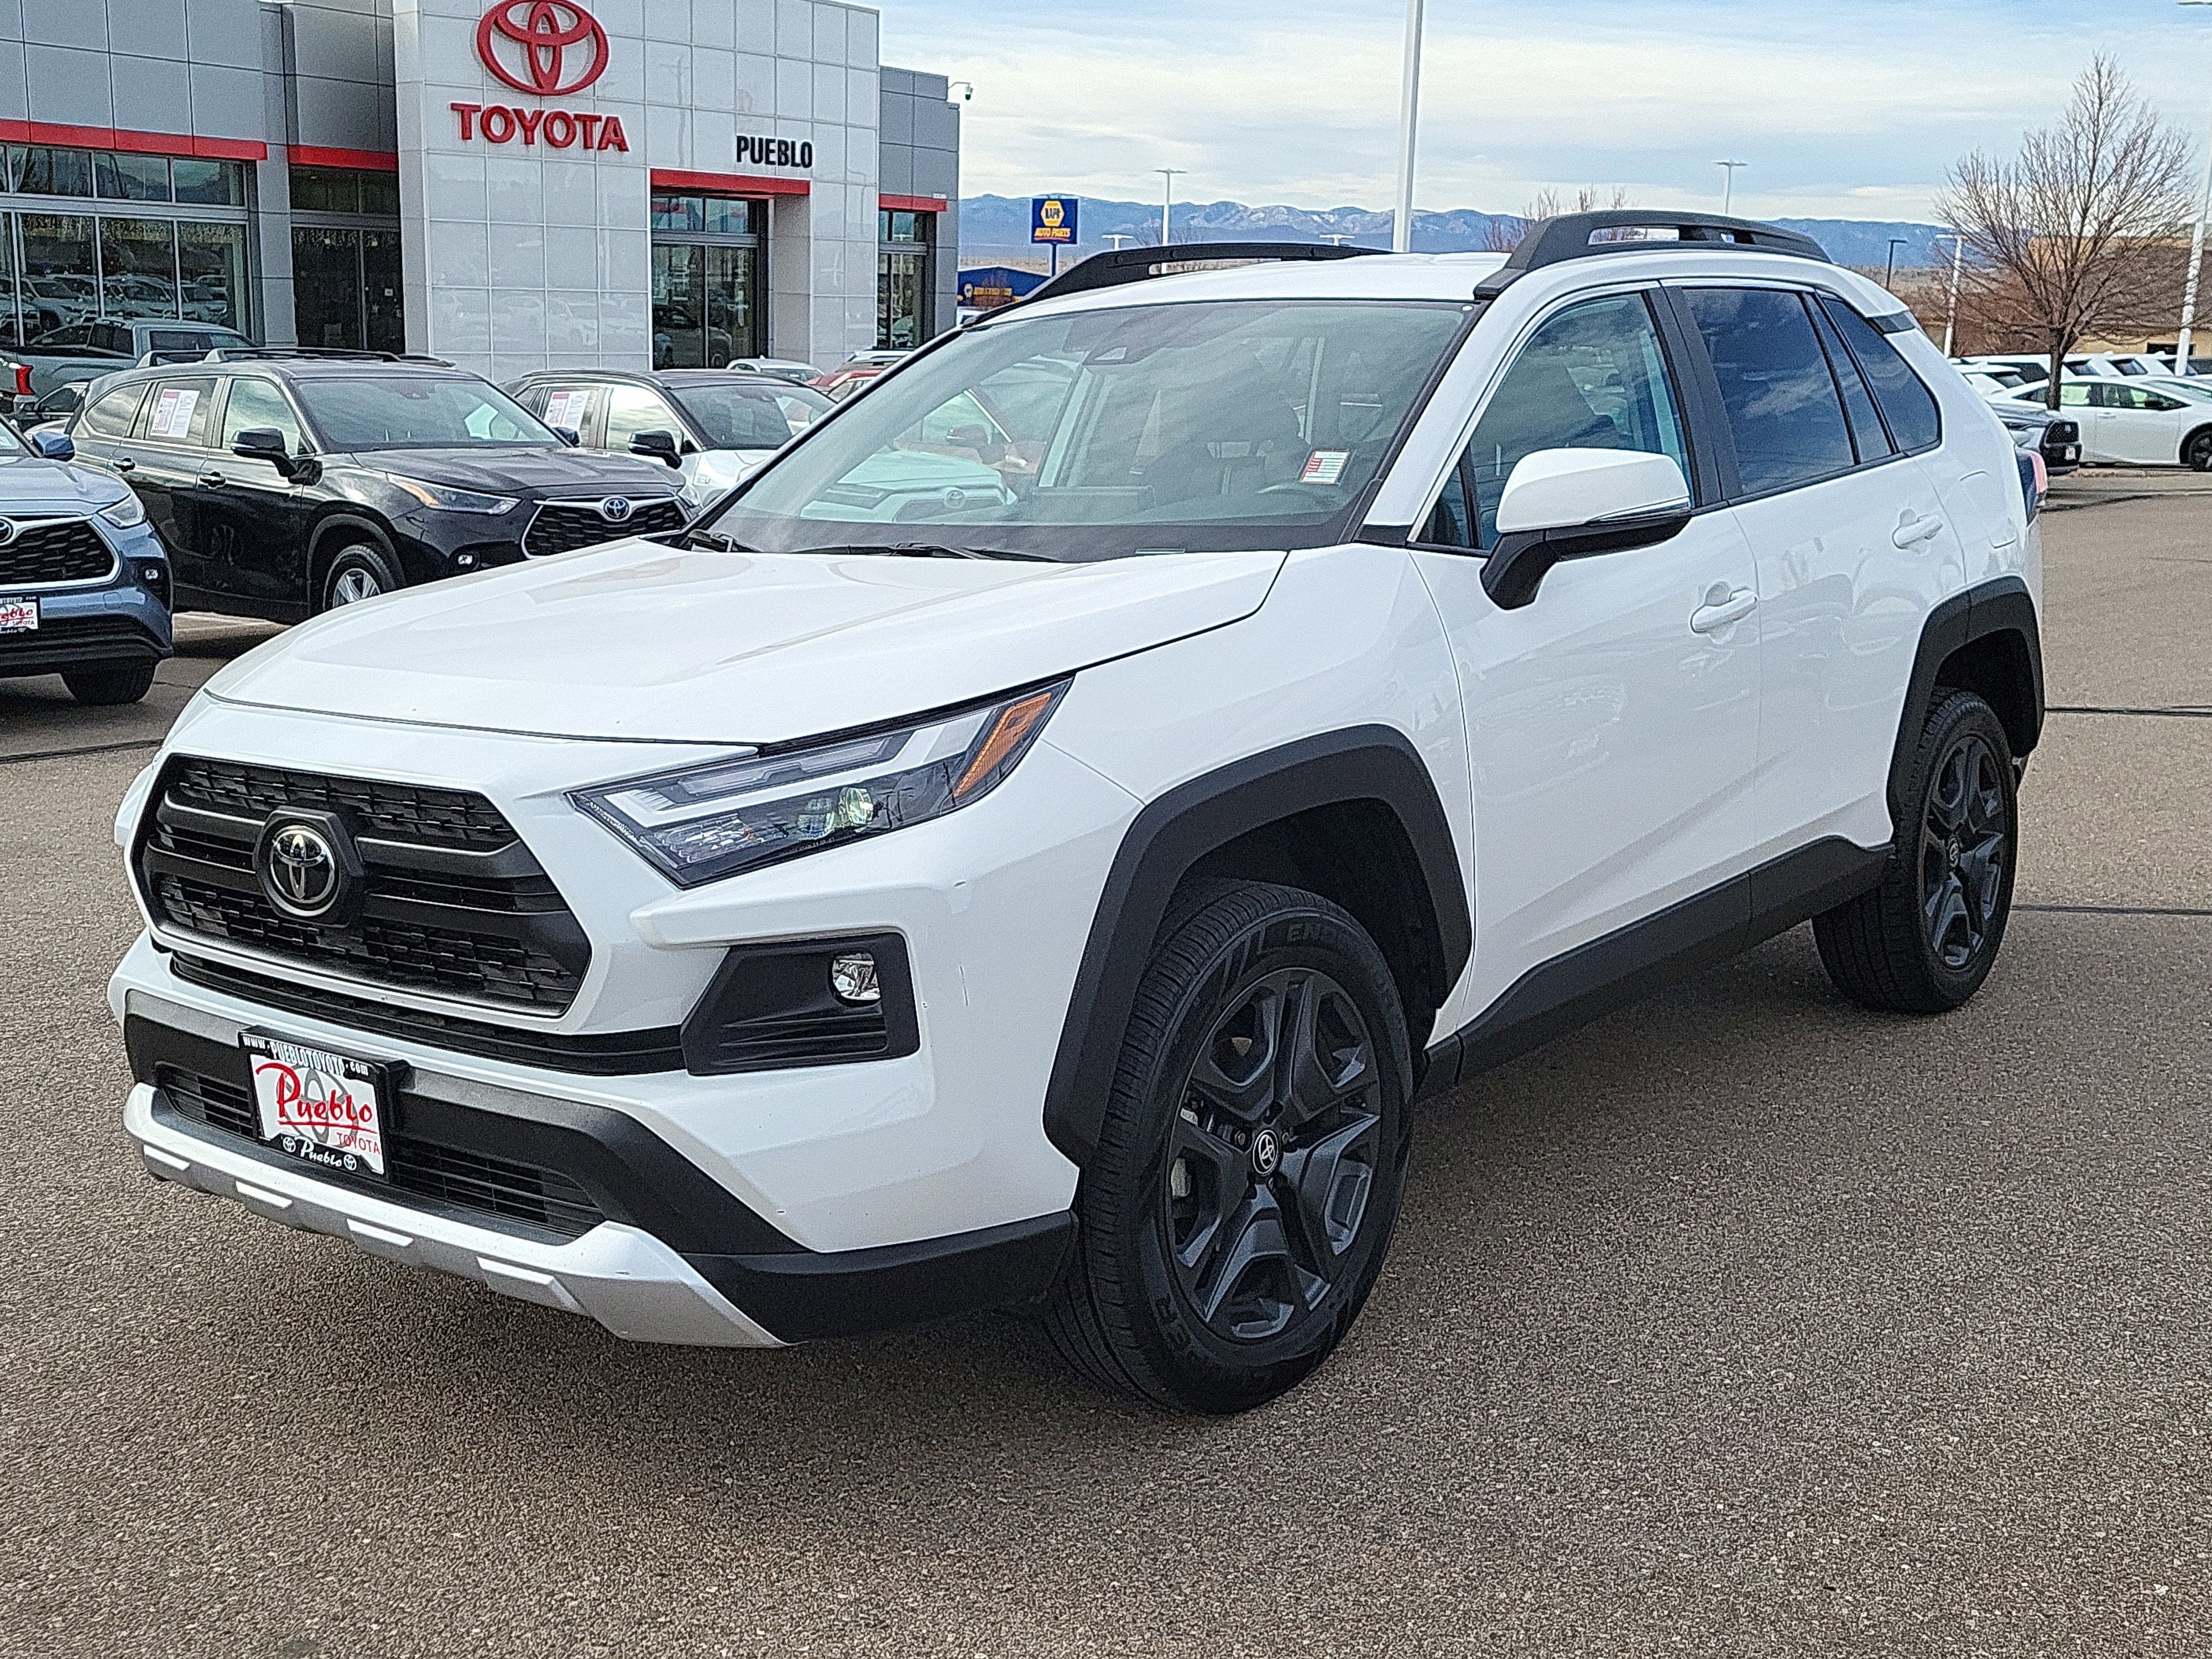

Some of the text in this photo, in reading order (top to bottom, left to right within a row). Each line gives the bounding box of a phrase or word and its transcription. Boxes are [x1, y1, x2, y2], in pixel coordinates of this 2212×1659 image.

[450, 102, 629, 152] TOYOTA
[736, 135, 812, 168] PUEBLO
[255, 1062, 373, 1123] Pueblo
[295, 1136, 342, 1167] Pueblo
[336, 1132, 380, 1155] TOYOTA
